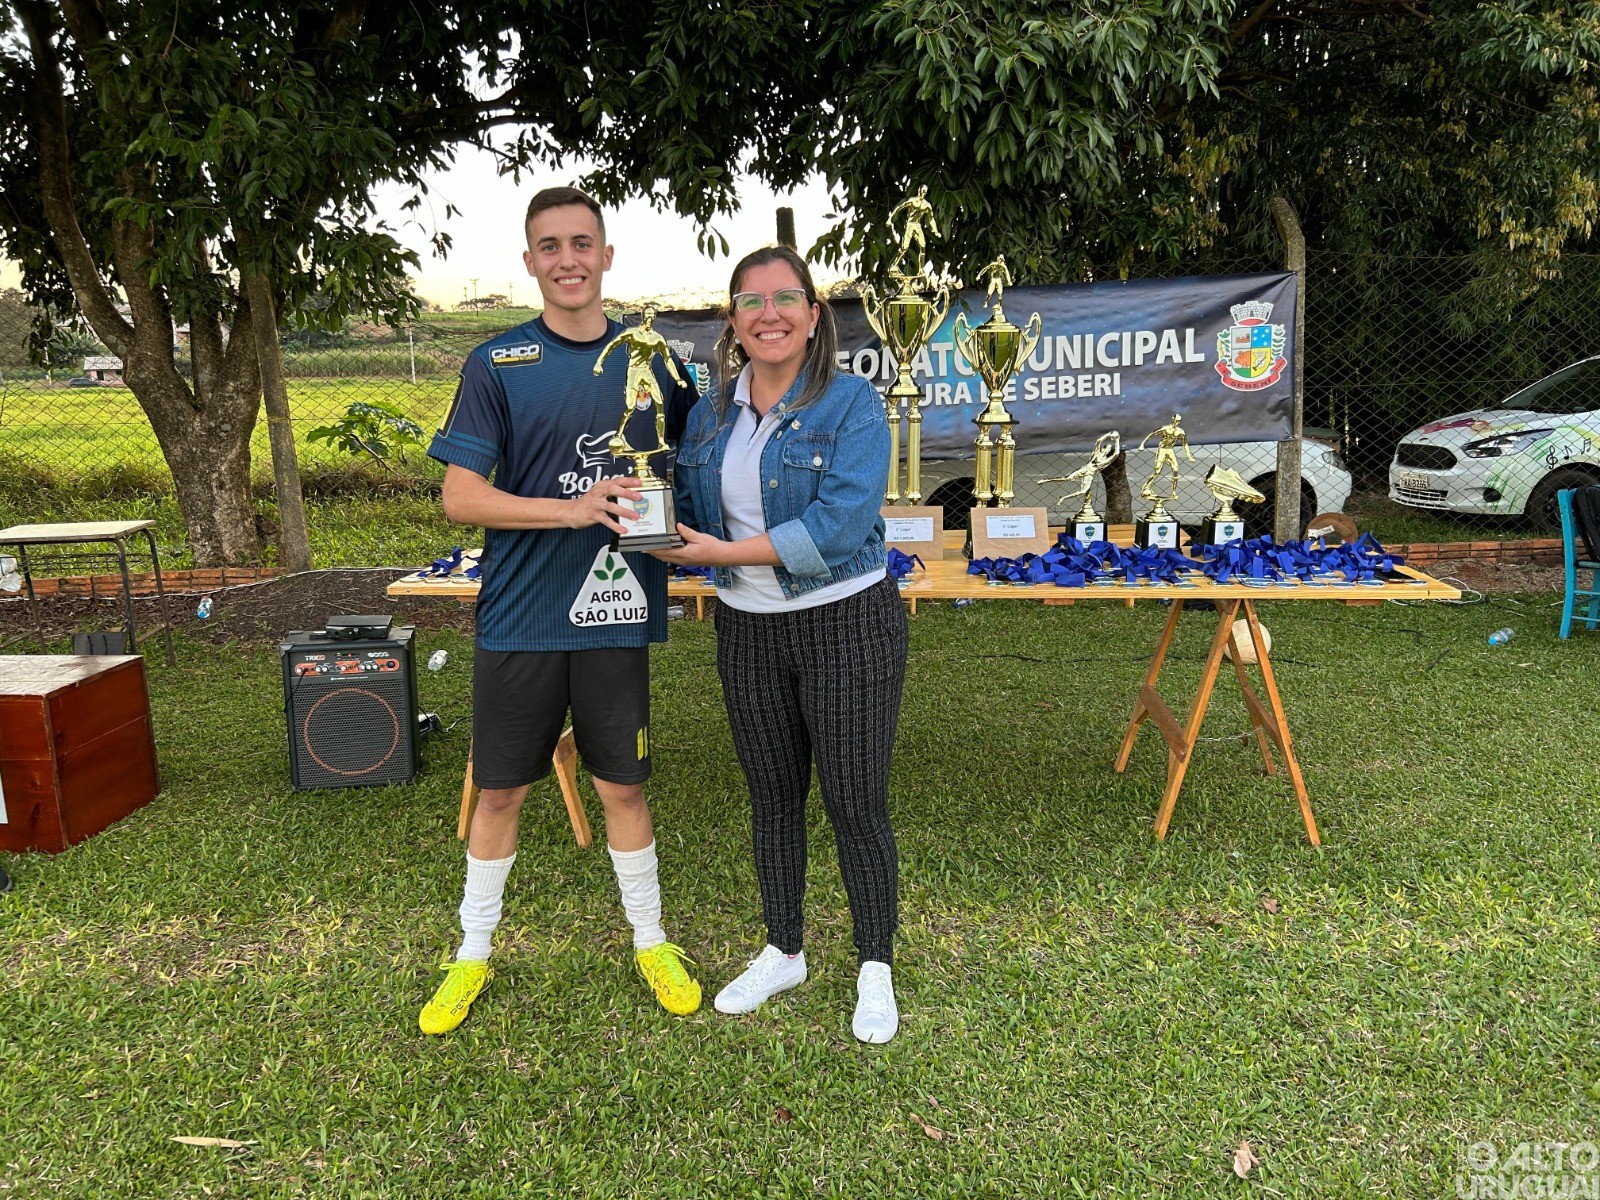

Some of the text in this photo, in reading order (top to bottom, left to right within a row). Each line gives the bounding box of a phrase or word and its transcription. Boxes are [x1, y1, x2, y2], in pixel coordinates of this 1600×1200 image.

[491, 344, 540, 359] CHICO
[1018, 328, 1205, 373] UNICIPAL
[1024, 372, 1121, 401] SEBERI
[590, 590, 632, 604] AGRO
[575, 607, 647, 625] SÃO LUIZ
[450, 977, 482, 1017] PENALTY
